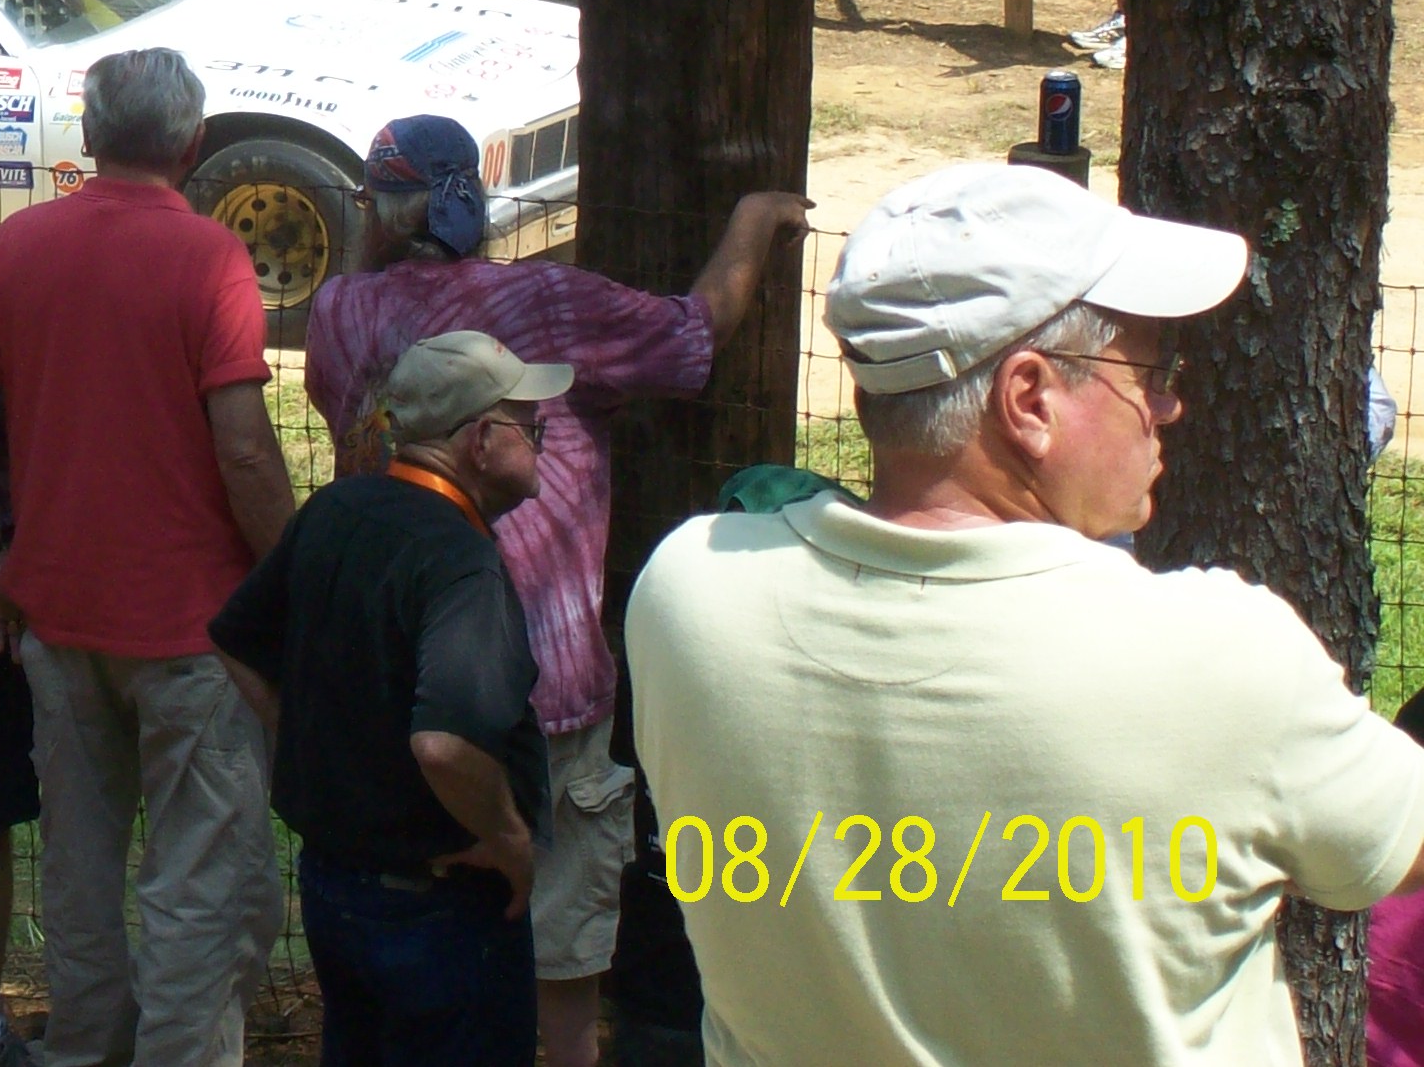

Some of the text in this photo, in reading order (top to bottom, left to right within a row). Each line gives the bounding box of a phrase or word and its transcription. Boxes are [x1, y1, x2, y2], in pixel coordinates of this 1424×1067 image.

[229, 87, 338, 113] GOODYEAR
[57, 168, 78, 185] 76
[482, 139, 506, 190] 00
